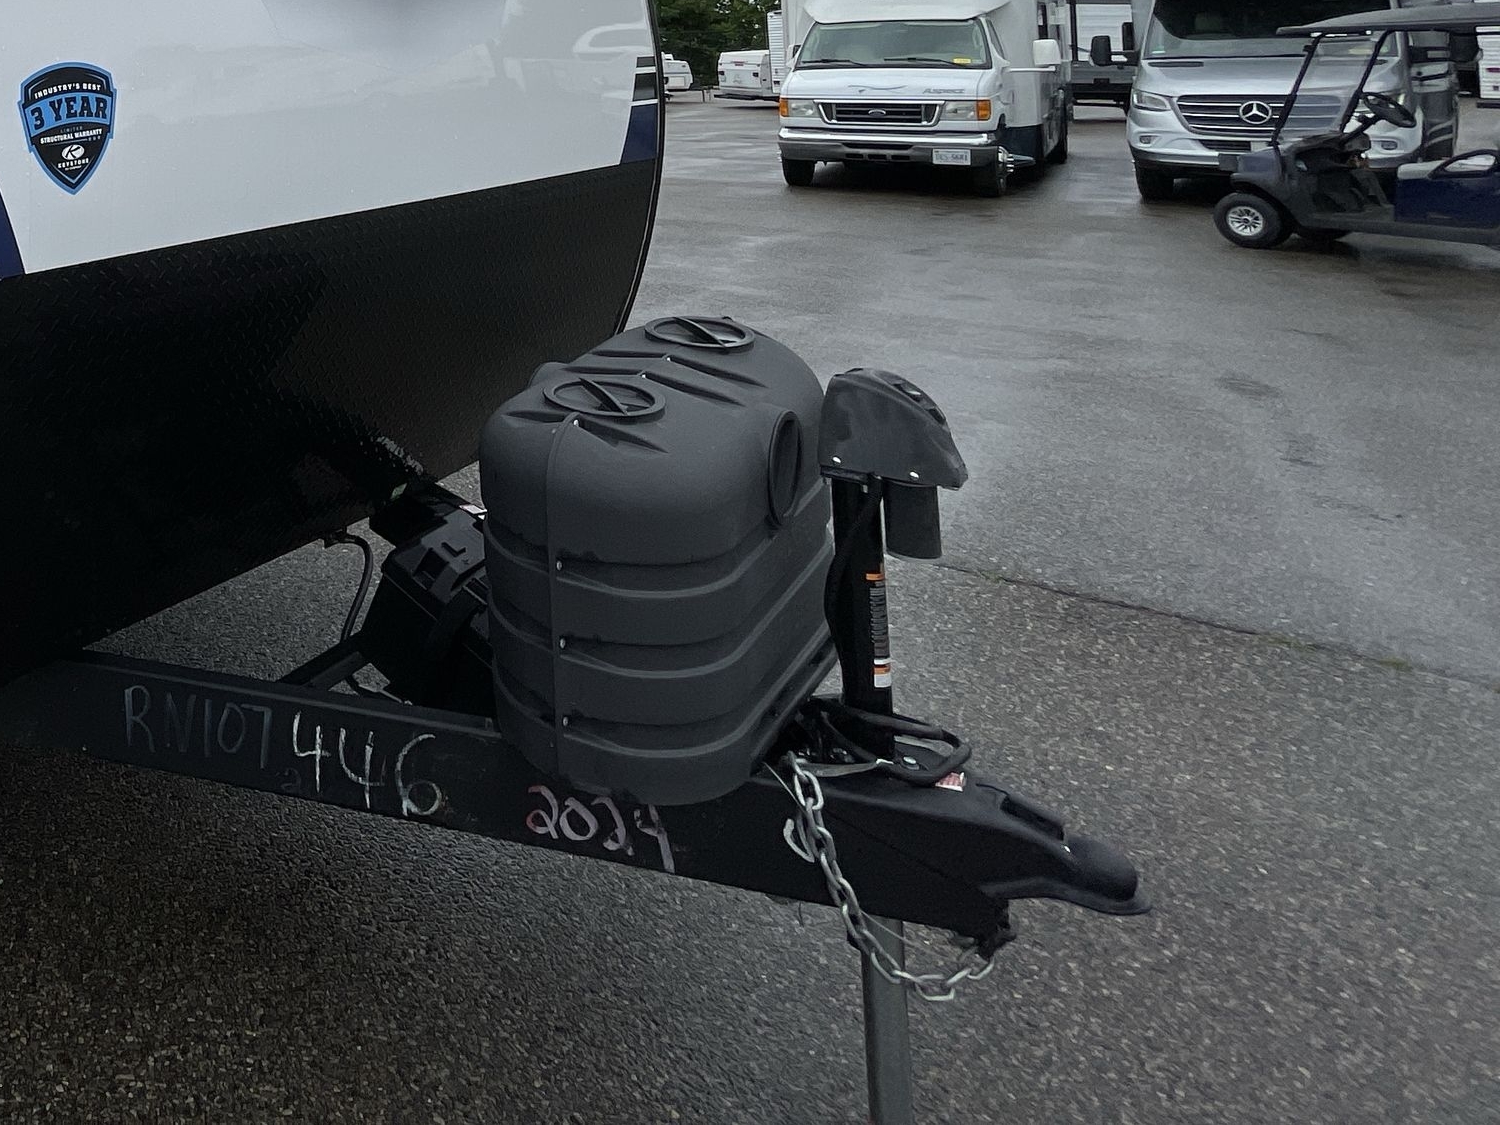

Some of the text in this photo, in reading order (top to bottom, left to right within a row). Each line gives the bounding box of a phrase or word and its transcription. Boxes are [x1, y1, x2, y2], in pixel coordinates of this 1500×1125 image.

[34, 83, 80, 99] INDUSTRY'S
[31, 96, 108, 130] 3 YEAR
[40, 128, 102, 144] STRUCTURAL WARRANTY
[57, 157, 89, 168] KEYSTONE
[526, 784, 676, 873] 2024
